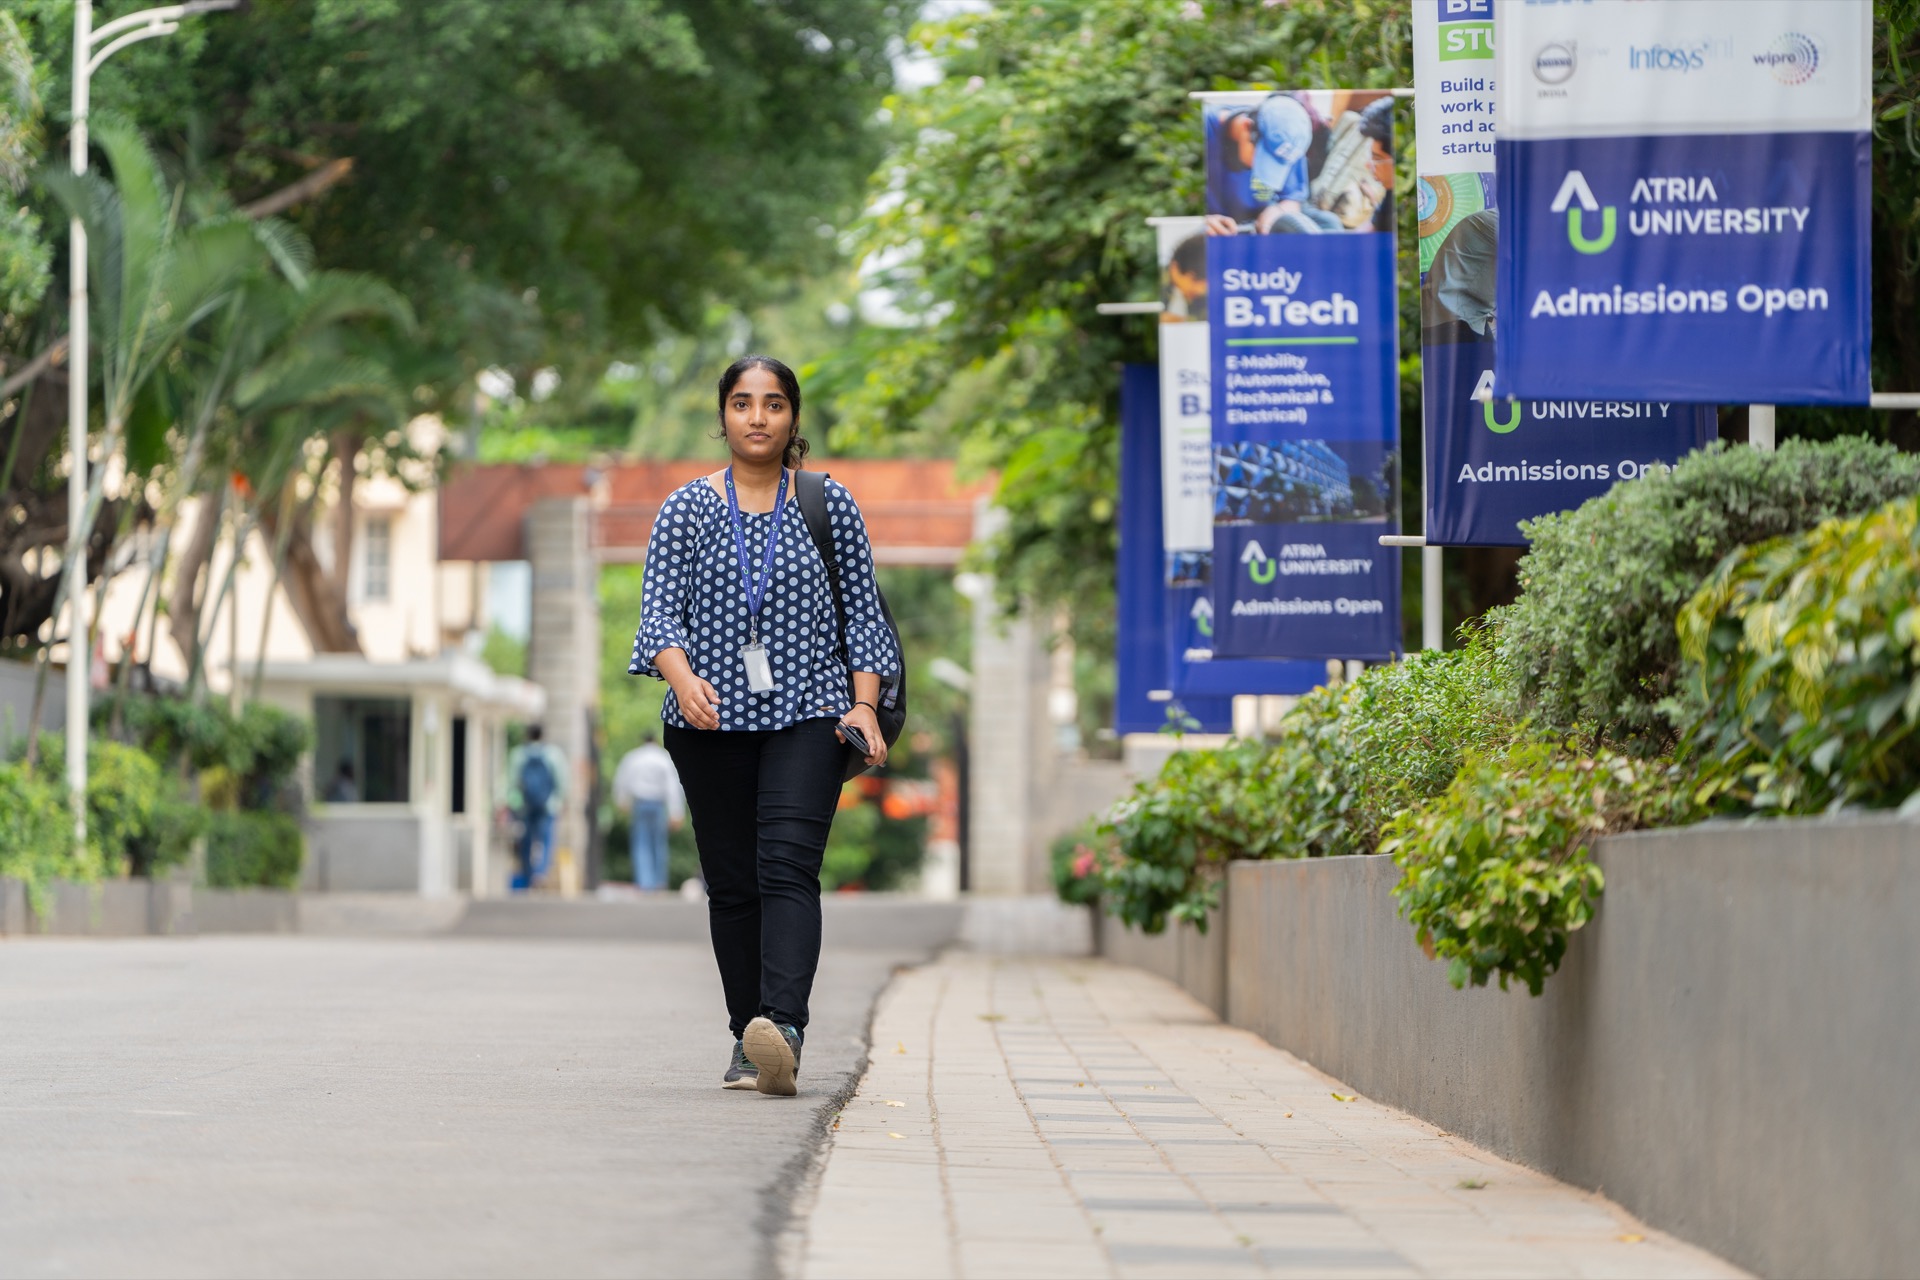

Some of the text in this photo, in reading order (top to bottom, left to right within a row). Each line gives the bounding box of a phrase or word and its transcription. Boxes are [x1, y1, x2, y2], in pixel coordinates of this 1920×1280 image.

[1629, 45, 1704, 73] Infosys
[1753, 51, 1797, 68] wipro
[1441, 78, 1484, 93] Build
[1441, 99, 1484, 114] work
[1441, 120, 1474, 135] and
[1442, 141, 1496, 156] startu
[1630, 176, 1717, 203] ATRIA
[1629, 206, 1810, 236] UNIVERSITY
[1222, 266, 1303, 295] Study
[1224, 292, 1359, 328] B.Tech
[1530, 284, 1829, 319] Admissions Open
[1225, 353, 1308, 371] E-Mobility
[1225, 389, 1334, 406] Mechanical &
[1226, 406, 1308, 425] Electrical)
[1532, 401, 1671, 420] UNIVERSITY
[1457, 459, 1610, 484] Admissions
[1280, 543, 1328, 559] ATRIA
[1279, 560, 1374, 576] UNIVERSITY
[1231, 597, 1384, 617] Admissions Open
